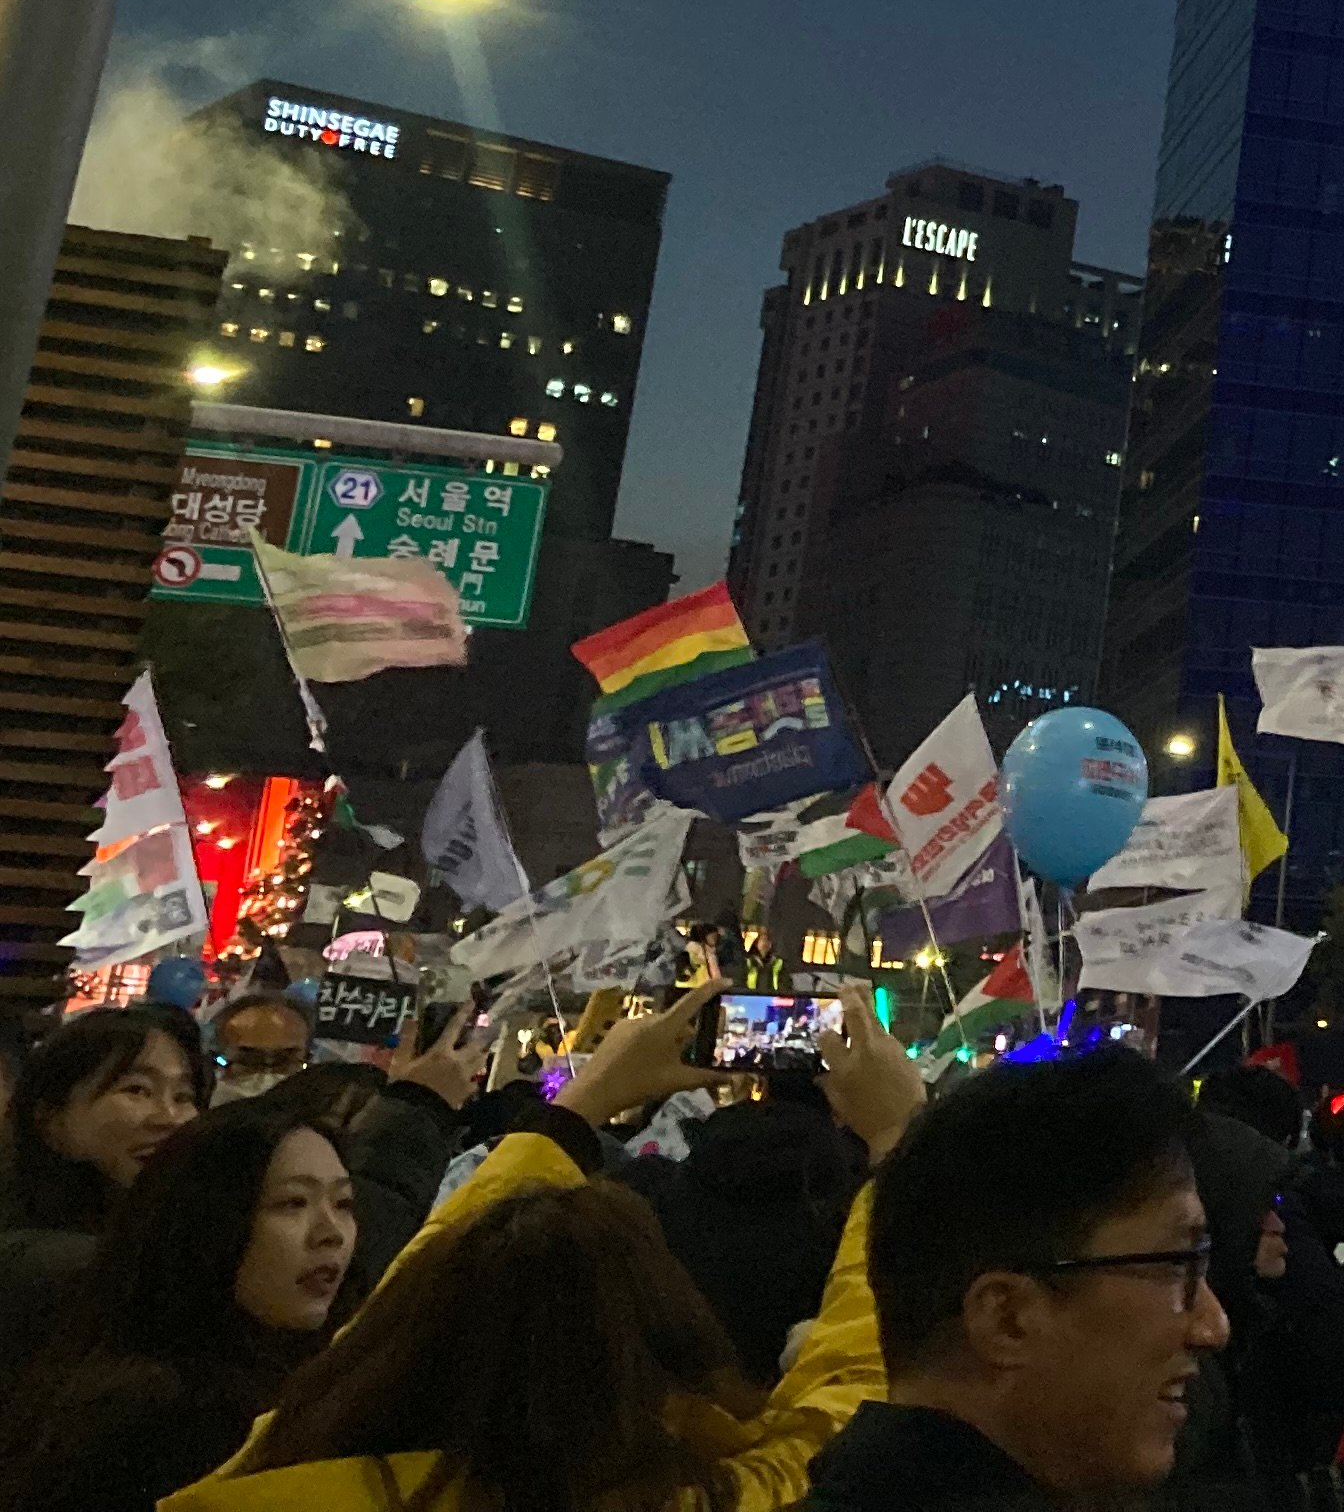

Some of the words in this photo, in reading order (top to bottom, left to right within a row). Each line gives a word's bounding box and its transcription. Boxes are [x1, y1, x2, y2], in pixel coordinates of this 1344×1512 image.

[264, 117, 322, 141] DUTY
[339, 133, 396, 159] FREE
[267, 98, 400, 144] SHINSEGAE
[902, 216, 979, 262] L'ESCAPE
[341, 477, 372, 501] 21
[398, 478, 513, 517] 서울역
[172, 492, 267, 528] 대성당
[396, 507, 454, 531] Seoul
[462, 514, 498, 535] Stn
[387, 534, 500, 572] 숭례문
